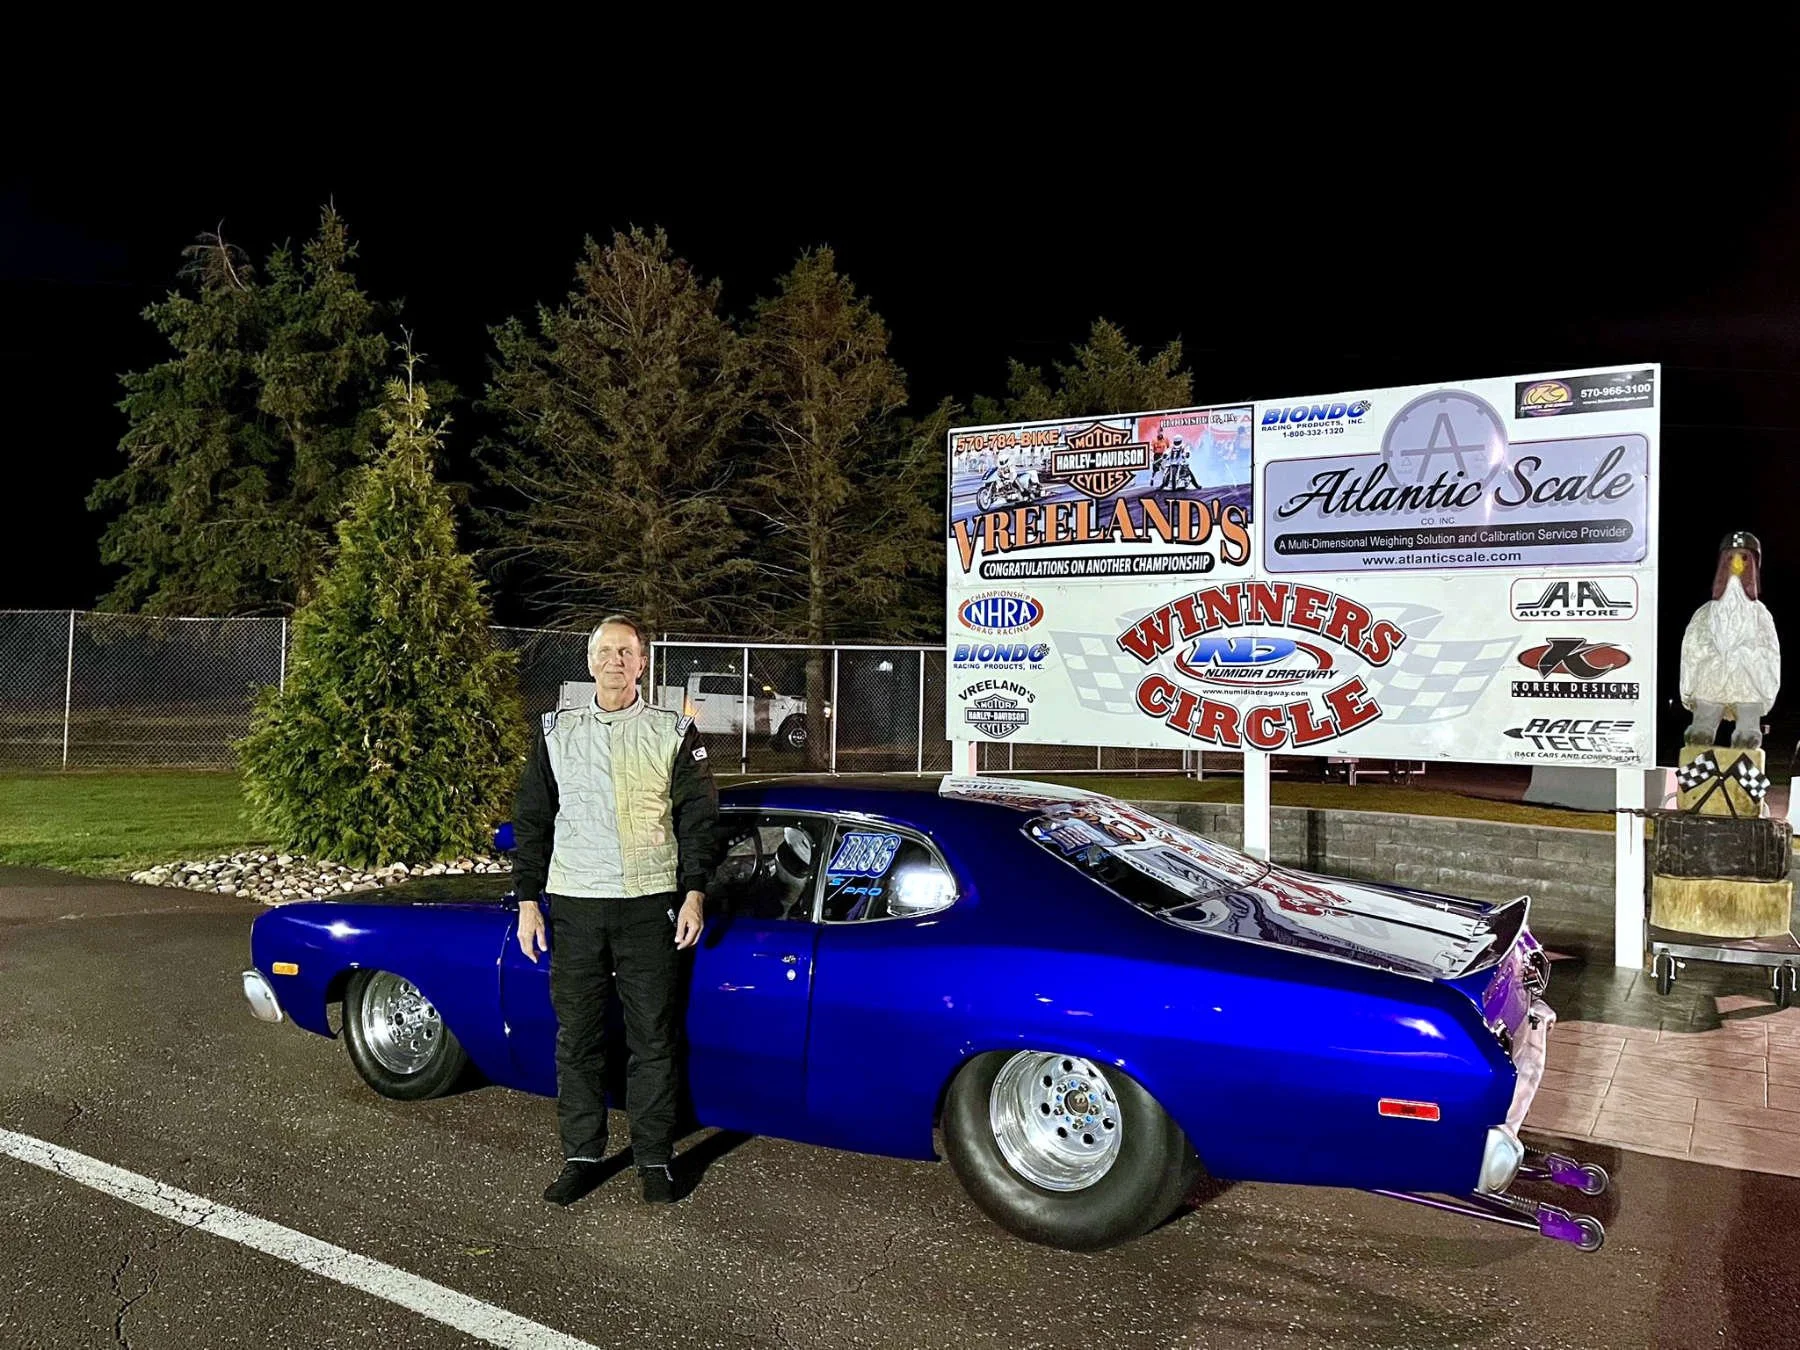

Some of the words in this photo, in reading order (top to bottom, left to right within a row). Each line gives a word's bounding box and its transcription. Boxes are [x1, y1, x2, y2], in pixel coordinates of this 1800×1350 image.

[1262, 401, 1372, 425] BIONDO
[956, 429, 1058, 453] 570-784-BIKE
[1075, 431, 1122, 449] MOTOR
[1282, 427, 1344, 438] 1-800-332-1320
[1056, 453, 1144, 472] HARLEY-DAVIDSON
[1076, 470, 1125, 493] CYCLES
[1277, 462, 1482, 517] Atlantic
[1494, 445, 1634, 508] Scale
[952, 497, 1252, 575] VREELAND'S
[1279, 540, 1286, 549] A
[1288, 535, 1368, 549] Multi-Dimensional
[1370, 534, 1413, 548] Weighing
[1416, 532, 1455, 546] Solution
[1458, 532, 1477, 543] and
[1480, 528, 1535, 542] Calibration
[1538, 526, 1578, 540] Service
[1581, 525, 1628, 538] Provider
[984, 561, 1068, 577] CONGRATULATIONS
[1070, 560, 1085, 574] ON
[1087, 558, 1131, 574] ANOTHER
[1133, 555, 1210, 572] CHAMPIONSHIP
[1362, 552, 1521, 566] www.atlanticscale.com
[970, 590, 1031, 602] CHAMPIONSHIP
[970, 599, 1032, 627] NHRA
[1566, 609, 1619, 617] STORE
[970, 624, 994, 635] DRAG
[997, 624, 1031, 636] RACING
[1117, 581, 1406, 667] WINNERS
[953, 643, 1050, 663] BIONDO
[984, 663, 1026, 671] PRODUCTS,
[1205, 668, 1262, 680] NUMIDIA
[1265, 669, 1339, 680] DRAGWAY
[958, 679, 1036, 704] VREELAND'S
[1202, 688, 1308, 698] www.numidiadragway.com
[1512, 682, 1560, 692] KOREK
[1570, 683, 1639, 693] DESIGNS
[1136, 674, 1382, 750] CIRCLE
[1524, 718, 1615, 735] RACE
